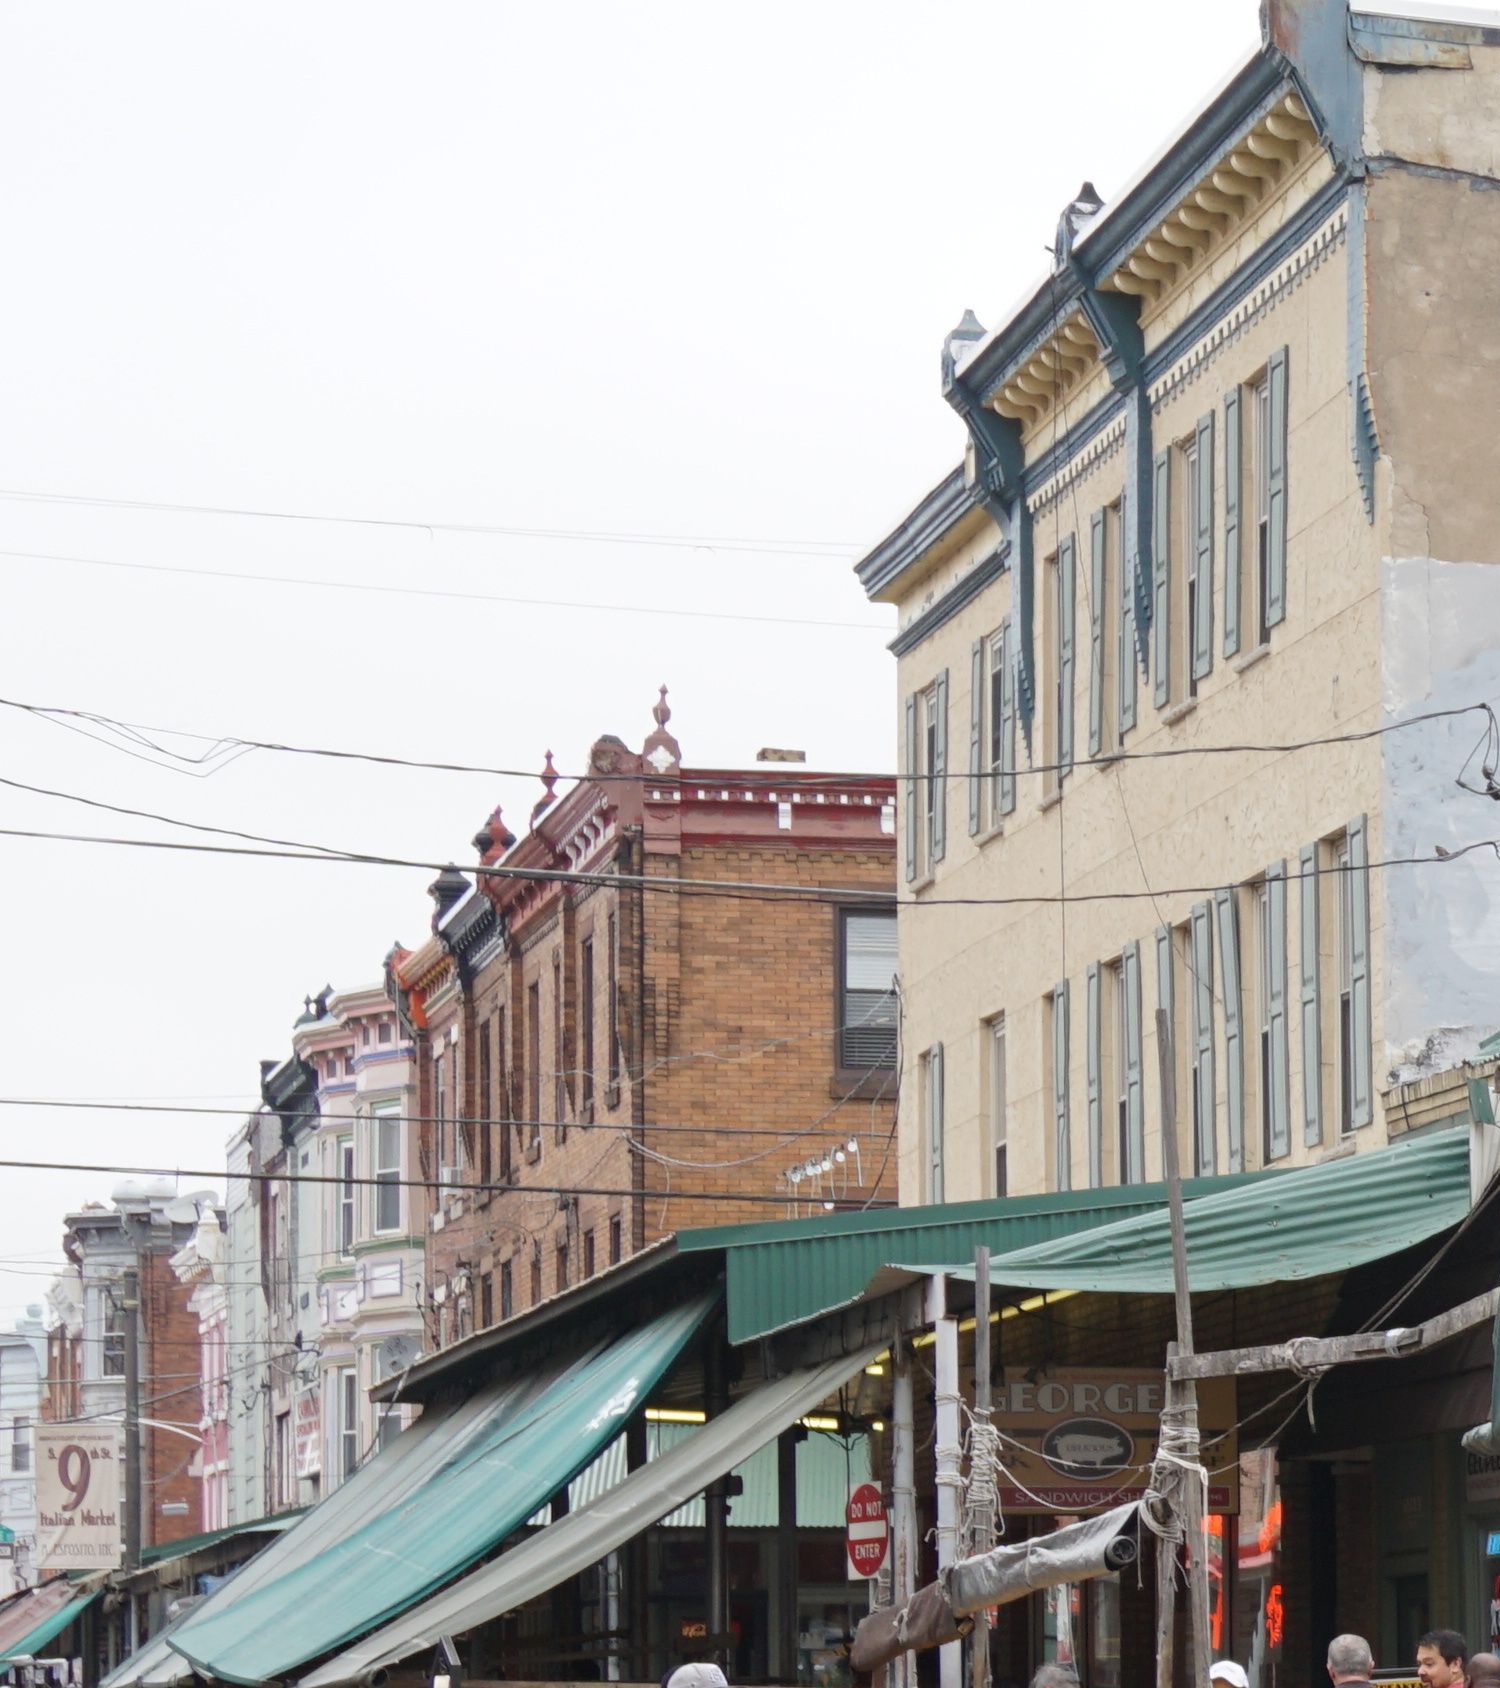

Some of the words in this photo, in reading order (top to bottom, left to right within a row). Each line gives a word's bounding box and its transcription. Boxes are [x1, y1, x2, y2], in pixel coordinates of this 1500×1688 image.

[992, 1382, 1162, 1413] EORGE
[57, 1444, 91, 1511] 9
[1015, 1491, 1113, 1504] SANDWICH
[1117, 1491, 1144, 1504] SH
[40, 1510, 75, 1526] Italian
[80, 1508, 116, 1526] Market
[851, 1504, 862, 1517] DO
[865, 1502, 882, 1516] NOT
[855, 1543, 881, 1560] ENTER
